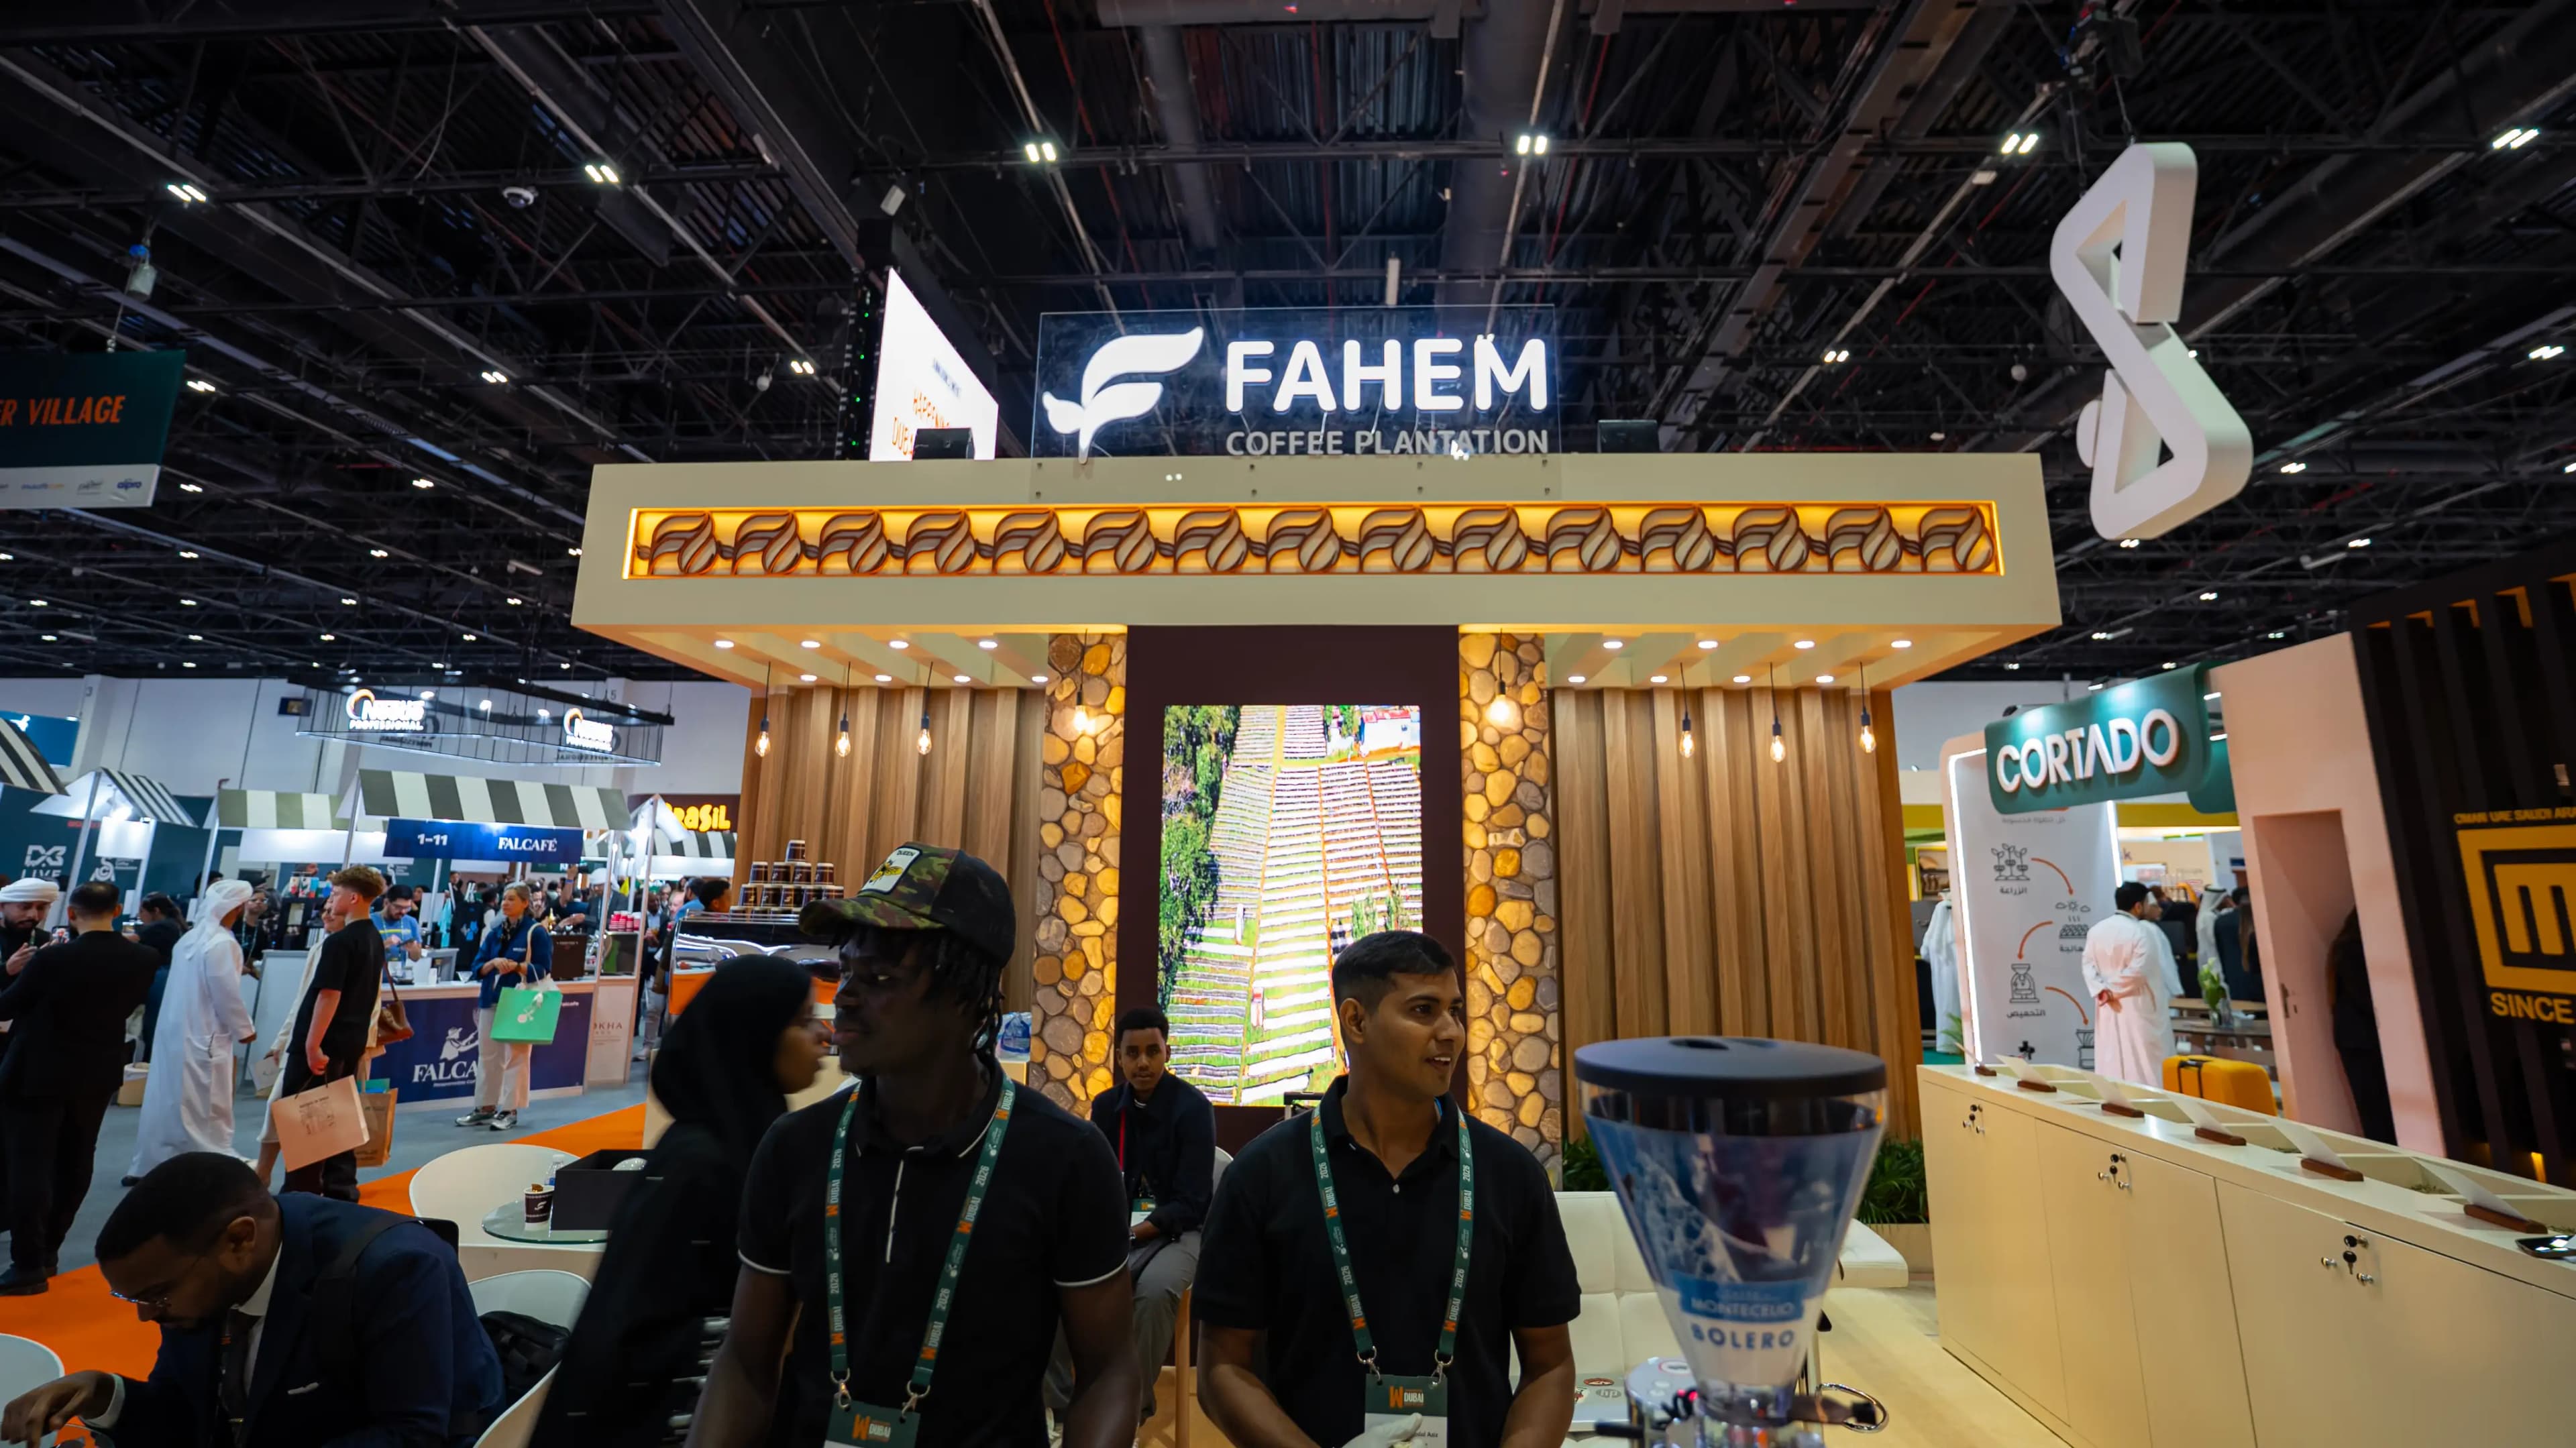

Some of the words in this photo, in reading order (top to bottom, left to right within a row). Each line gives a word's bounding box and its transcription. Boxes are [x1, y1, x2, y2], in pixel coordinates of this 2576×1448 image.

[1226, 339, 1548, 412] FAHEM
[29, 395, 126, 425] VILLAGE
[1226, 431, 1344, 455] COFFEE
[1355, 429, 1548, 455] PLANTATION
[1996, 708, 2180, 793] CORTADO
[417, 833, 448, 846] 1-11
[498, 836, 557, 852] FALCAFÉ
[2490, 992, 2575, 1024] SINCE
[412, 1060, 477, 1082] FALCA
[1318, 1162, 1329, 1179] 2026
[965, 1196, 981, 1222] DUBAI
[975, 1165, 990, 1187] 2026
[1325, 1186, 1336, 1207] DUBAI
[1463, 1190, 1472, 1211] DUBAI
[1340, 1265, 1353, 1286] 2026
[1454, 1268, 1465, 1288] 2026
[1349, 1293, 1363, 1317] DUBAI
[1449, 1298, 1461, 1321] DUBAI
[1690, 1323, 1795, 1350] BOLERO
[1403, 1392, 1424, 1403] DUBAI
[869, 1423, 891, 1439] DUBAI
